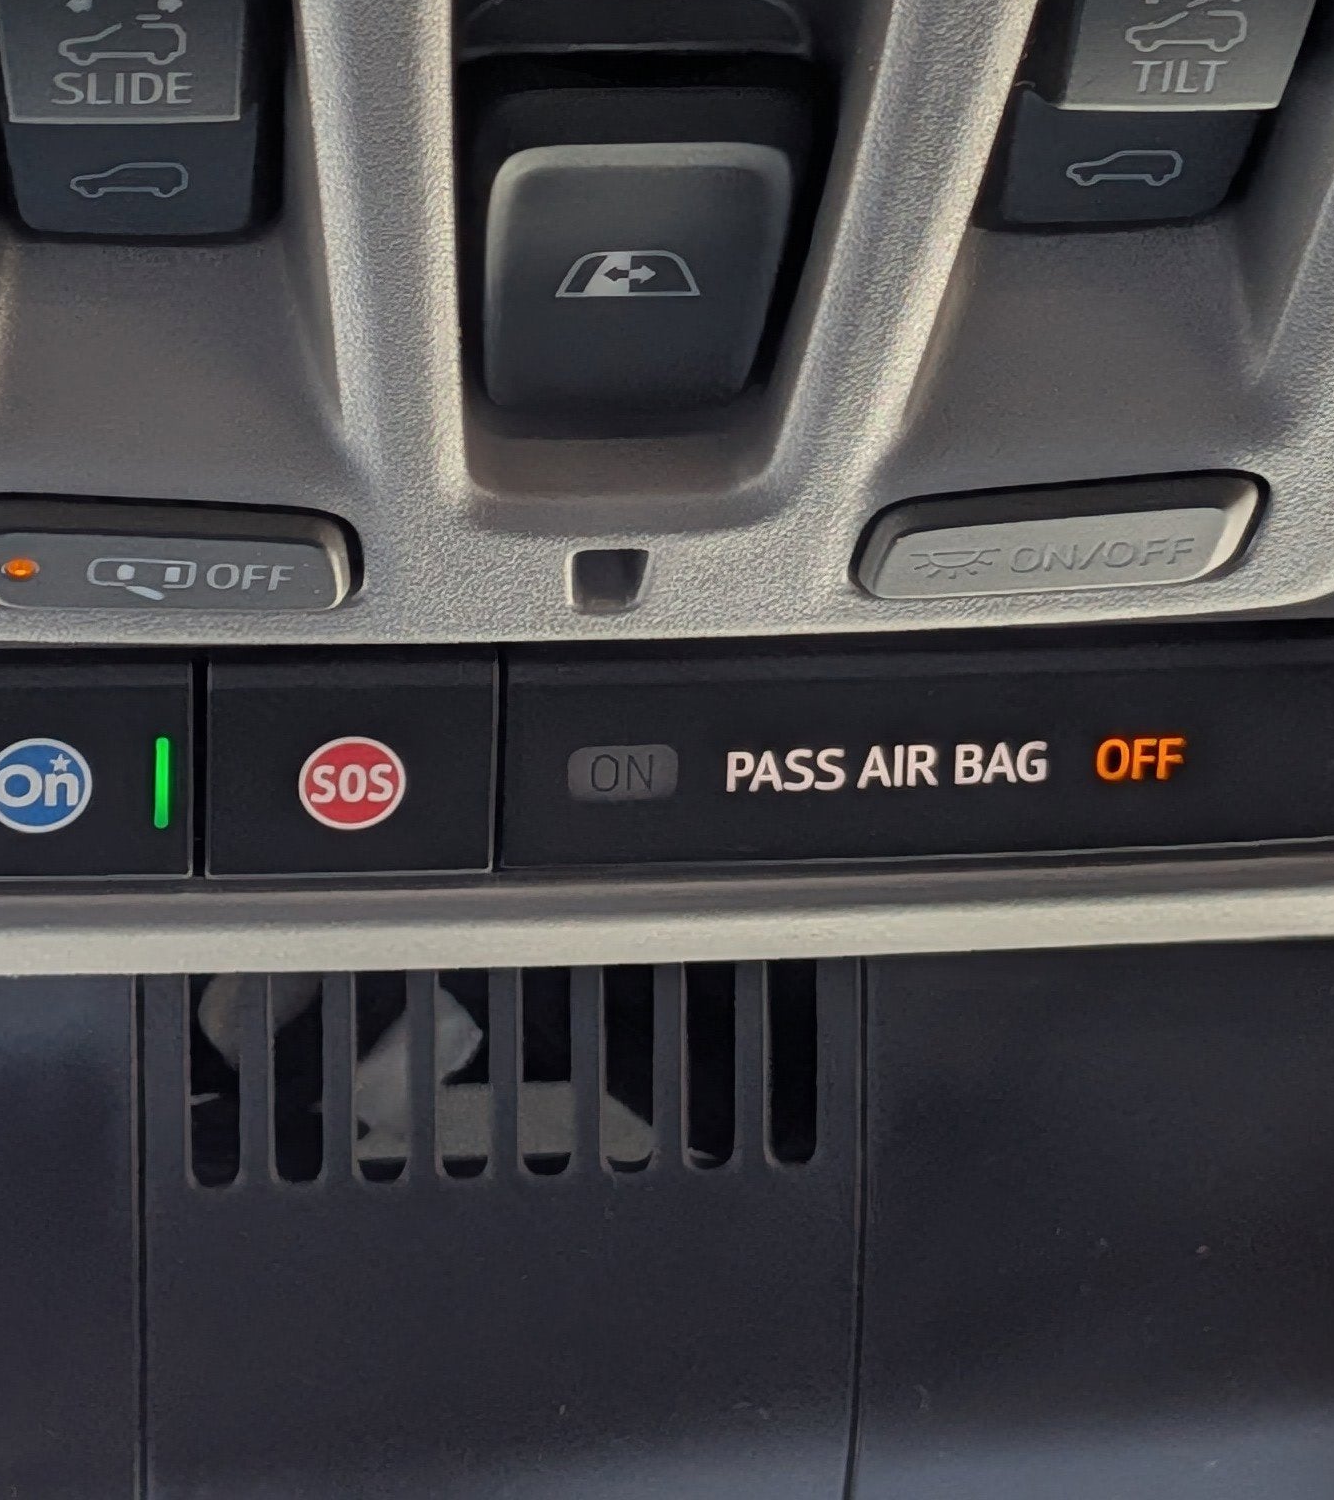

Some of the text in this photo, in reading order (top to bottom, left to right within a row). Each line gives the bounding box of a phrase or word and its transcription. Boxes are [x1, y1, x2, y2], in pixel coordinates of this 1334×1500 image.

[51, 72, 193, 105] SLIDE
[1132, 60, 1229, 93] TILT
[1010, 537, 1196, 574] ON/OFF
[206, 563, 295, 591] OFF
[590, 755, 655, 792] ON
[725, 741, 1050, 792] PASS AIR BAG
[1095, 738, 1184, 780] OFF
[311, 764, 393, 803] SOS
